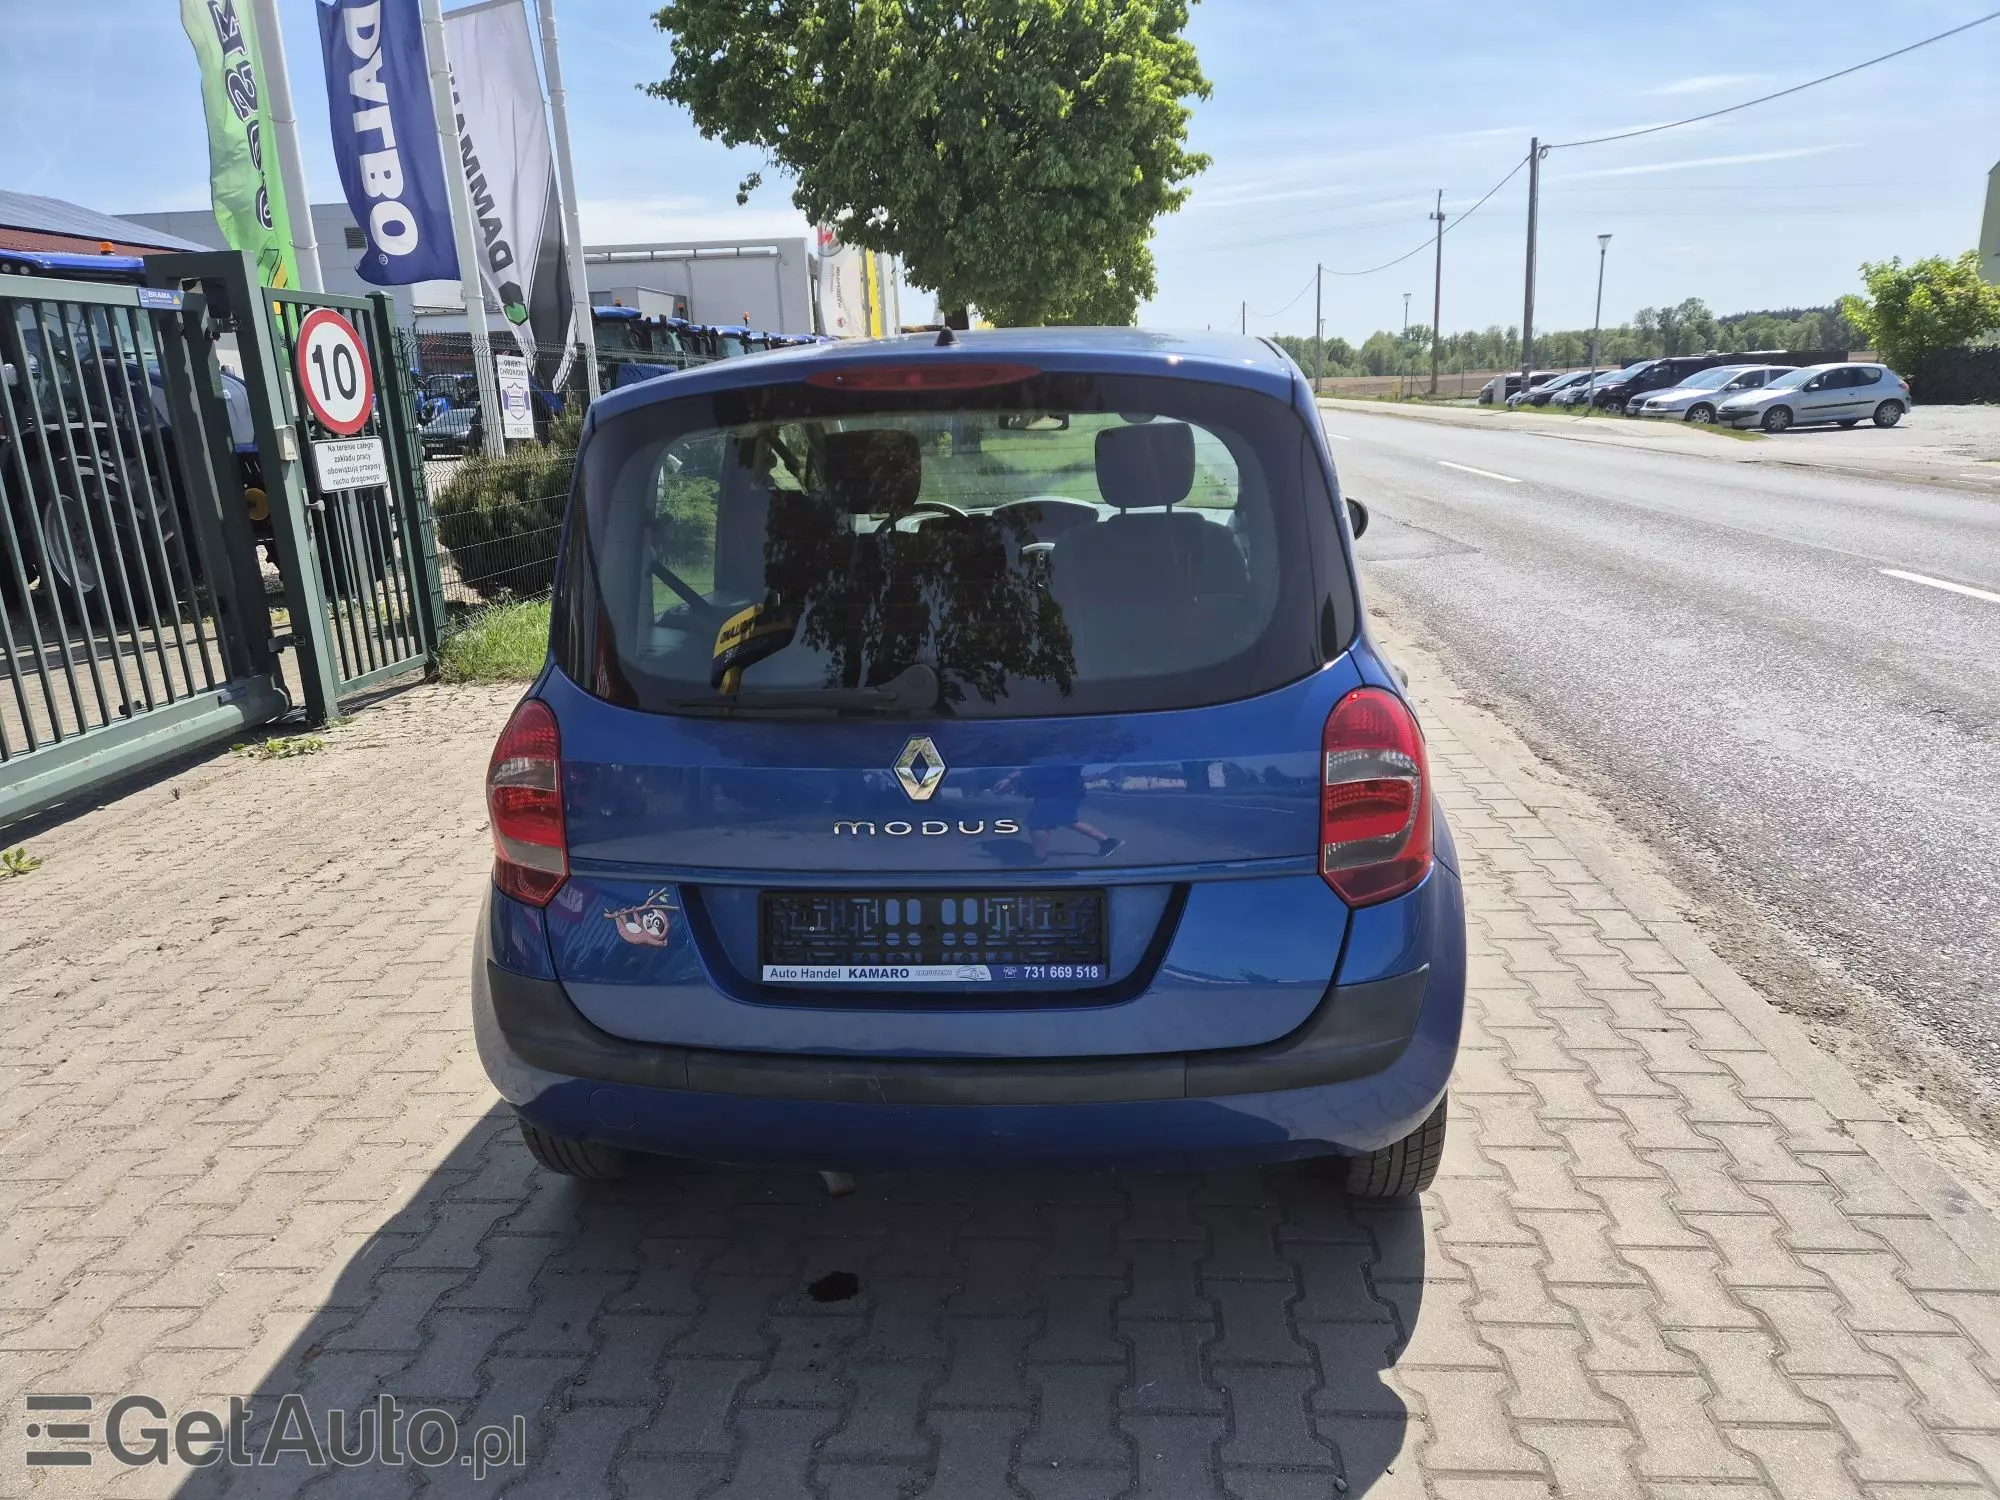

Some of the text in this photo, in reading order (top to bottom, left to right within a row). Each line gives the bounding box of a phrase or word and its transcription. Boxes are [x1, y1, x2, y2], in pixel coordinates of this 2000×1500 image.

[148, 290, 171, 299] BRAMA
[312, 343, 357, 401] 10
[336, 443, 355, 451] terenie
[357, 453, 370, 461] pracy
[360, 463, 381, 472] przepisy
[333, 474, 379, 485] ruchu drogowego
[833, 819, 1019, 835] MODUS
[770, 968, 797, 978] Auto
[801, 968, 841, 978] Handel
[848, 968, 909, 978] KAMARO
[1024, 966, 1045, 978] 731
[1050, 966, 1072, 978] 669
[1076, 966, 1099, 978] 518
